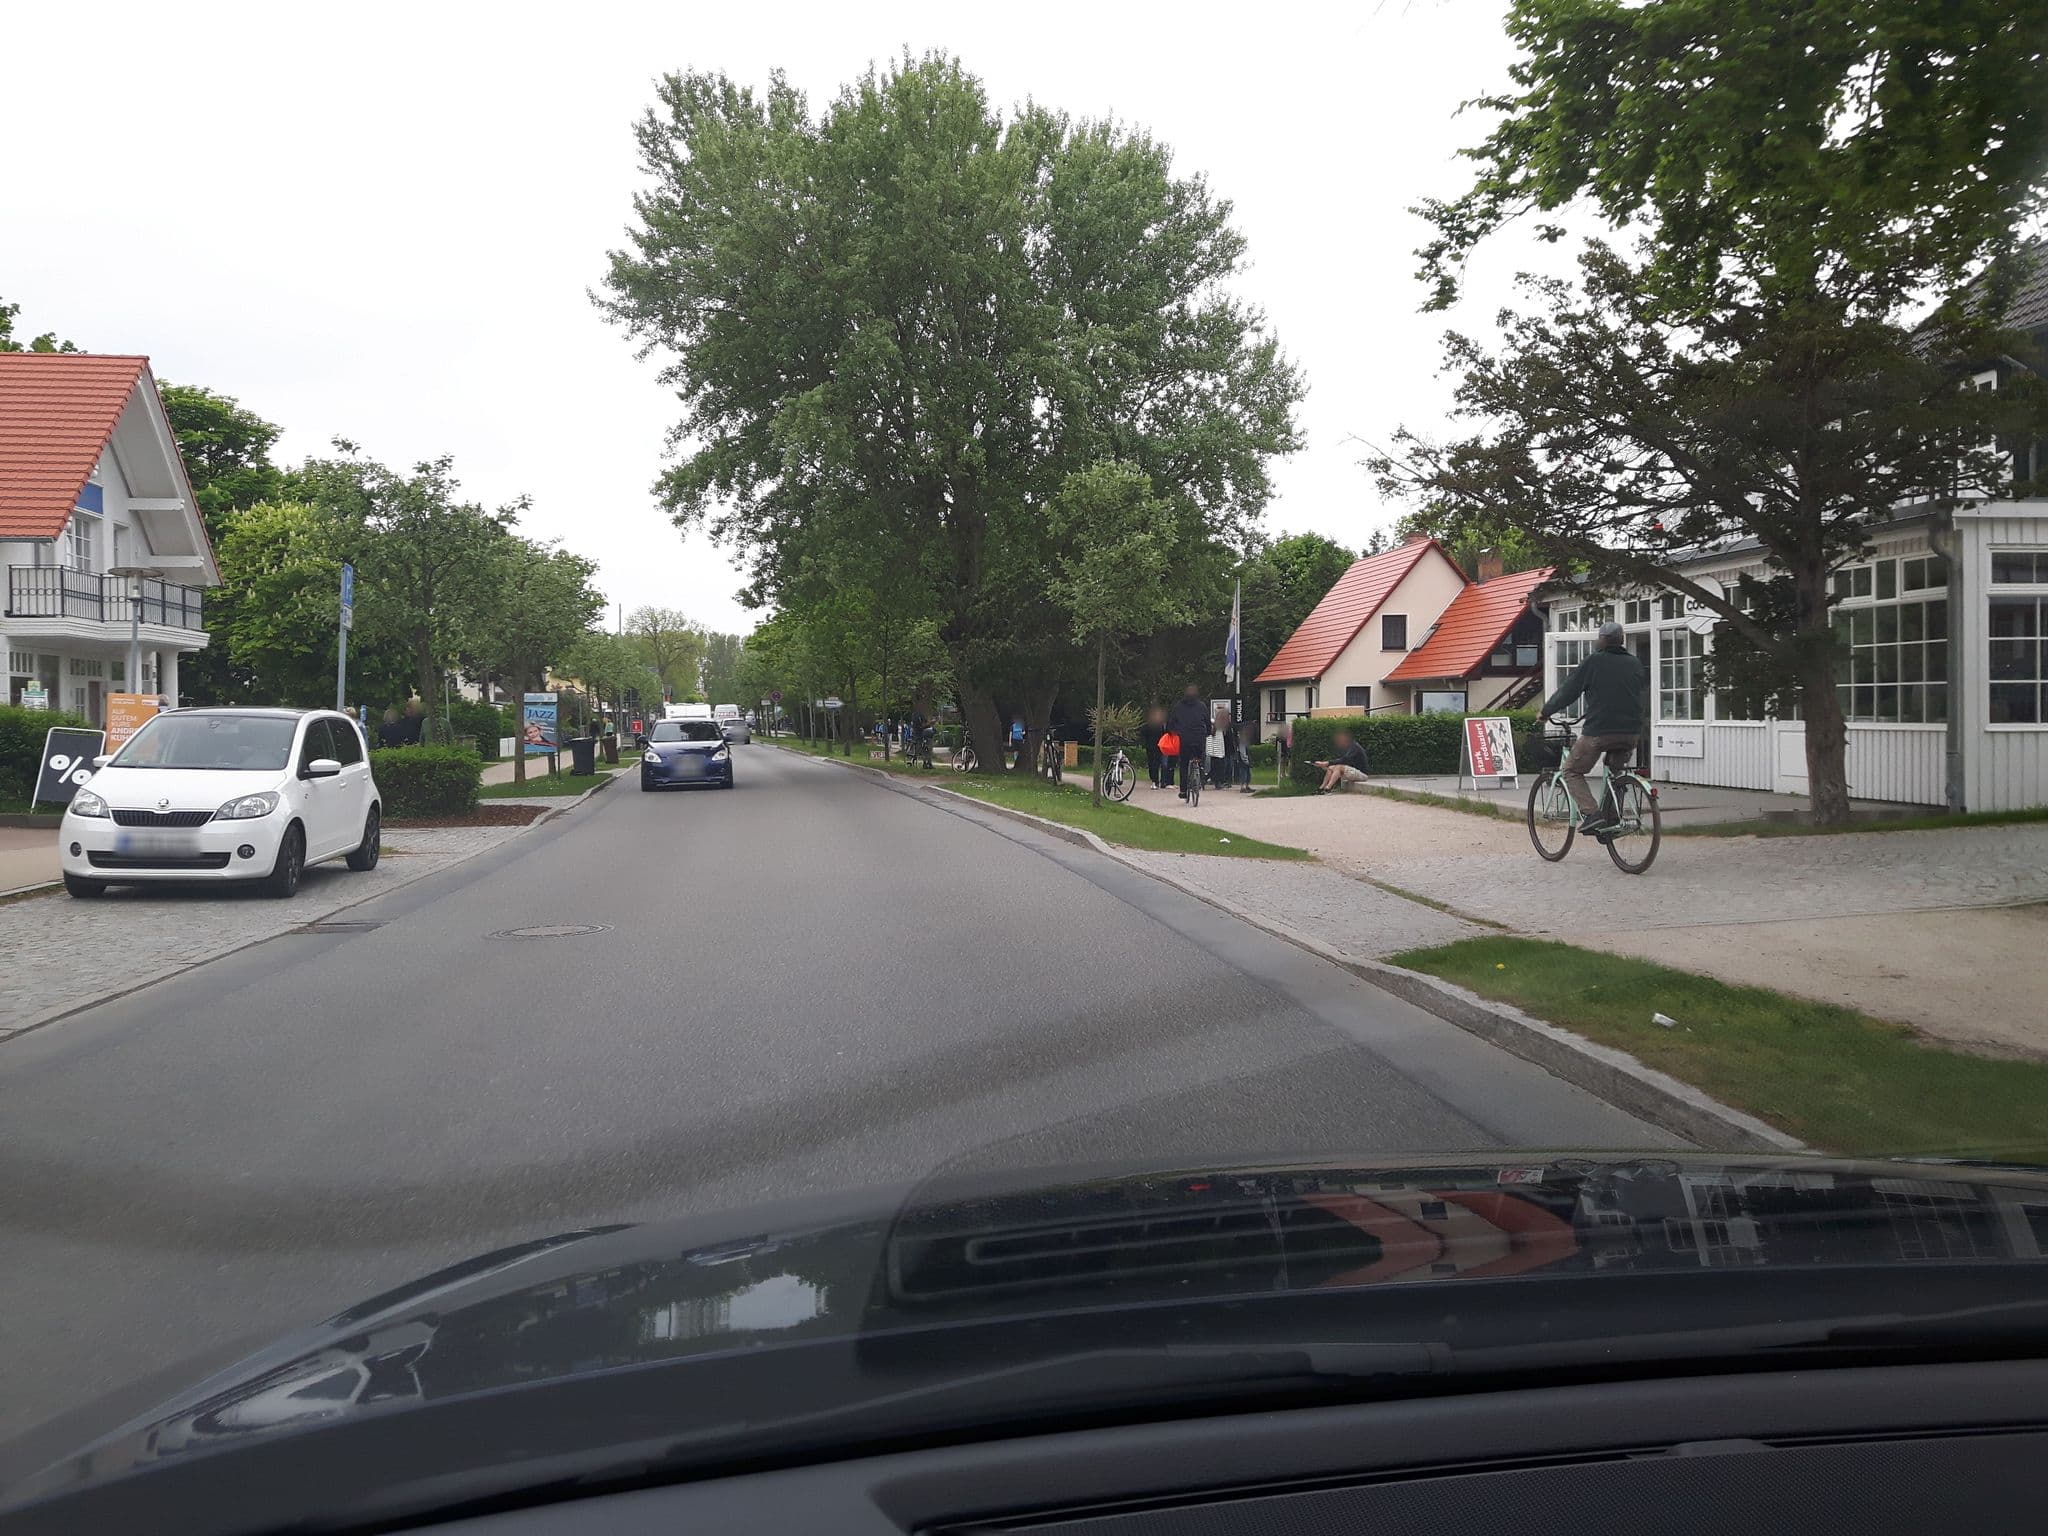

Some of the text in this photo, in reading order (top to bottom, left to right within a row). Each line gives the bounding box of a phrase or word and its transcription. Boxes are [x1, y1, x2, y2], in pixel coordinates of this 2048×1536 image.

[527, 709, 555, 719] JAZZ
[1475, 723, 1489, 761] reduziert
[1474, 751, 1486, 772] stark
